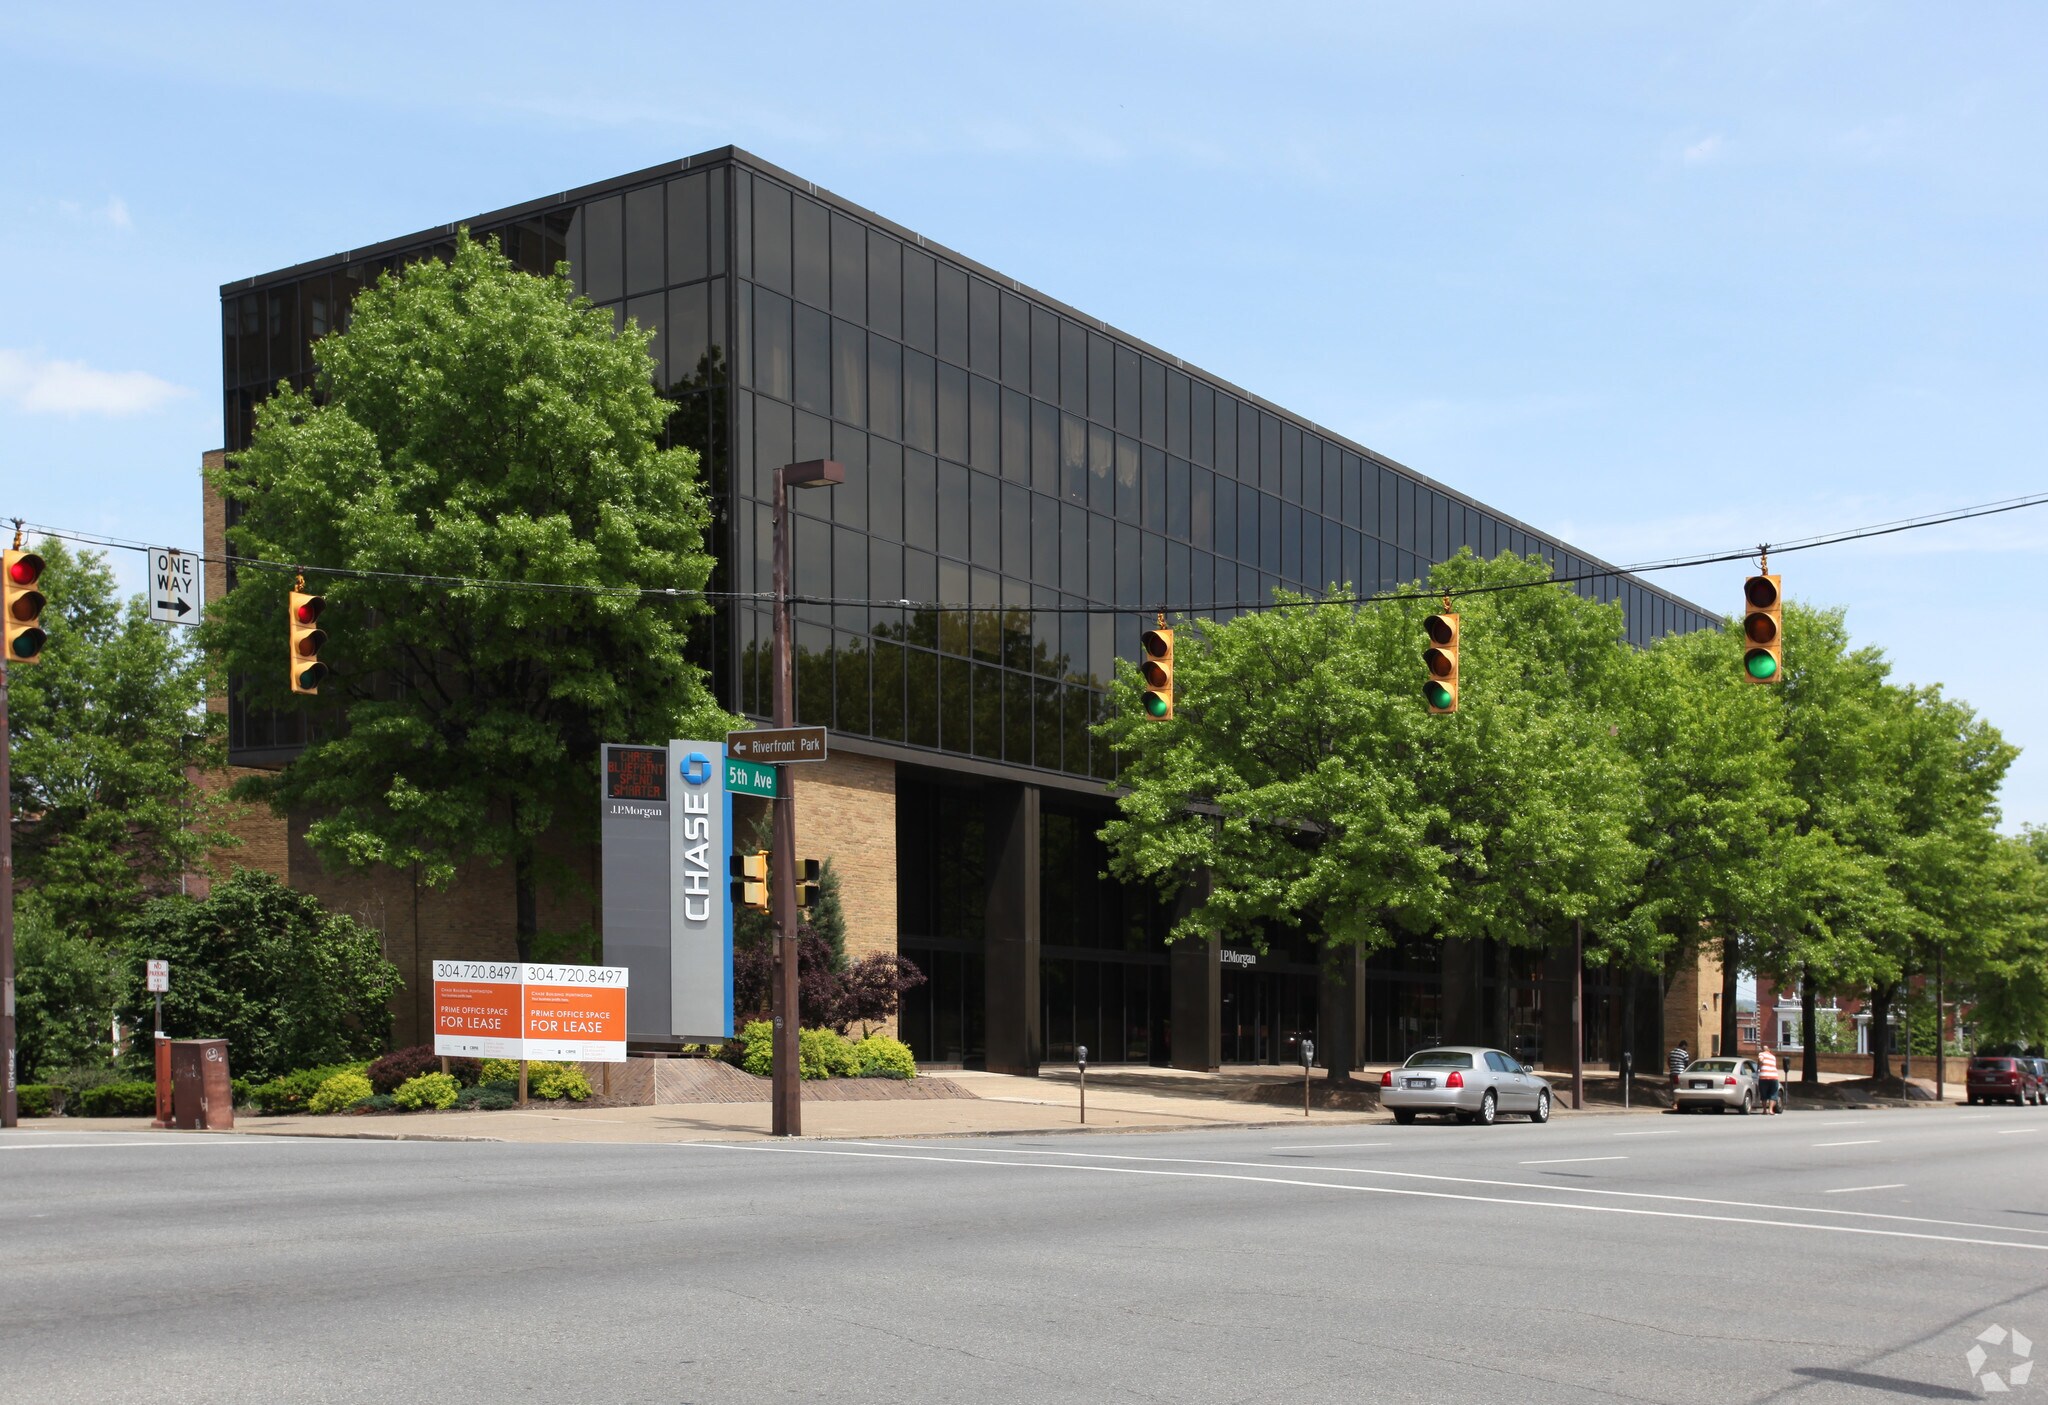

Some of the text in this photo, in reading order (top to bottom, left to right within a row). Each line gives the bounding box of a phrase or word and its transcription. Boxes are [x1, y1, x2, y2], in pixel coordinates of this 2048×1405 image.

[158, 555, 191, 575] ONE
[157, 574, 192, 594] WAY
[752, 738, 820, 753] Riverfront Park
[621, 751, 653, 763] CHASE
[608, 761, 665, 775] BLUEPRINT
[620, 773, 653, 785] SPEND
[729, 766, 772, 789] 5th Ave
[613, 784, 661, 797] SMARTER
[610, 805, 662, 818] J.P.Morgan
[684, 792, 710, 921] CHASE
[438, 963, 518, 980] 304.720.8497
[528, 966, 622, 984] 304.720.8497
[440, 1006, 508, 1016] PRIME OFFICE SPACE
[530, 1009, 611, 1019] PRIME OFFICE SPACE
[441, 1016, 502, 1030] FOR LEASE
[531, 1020, 602, 1033] FOR LEASE
